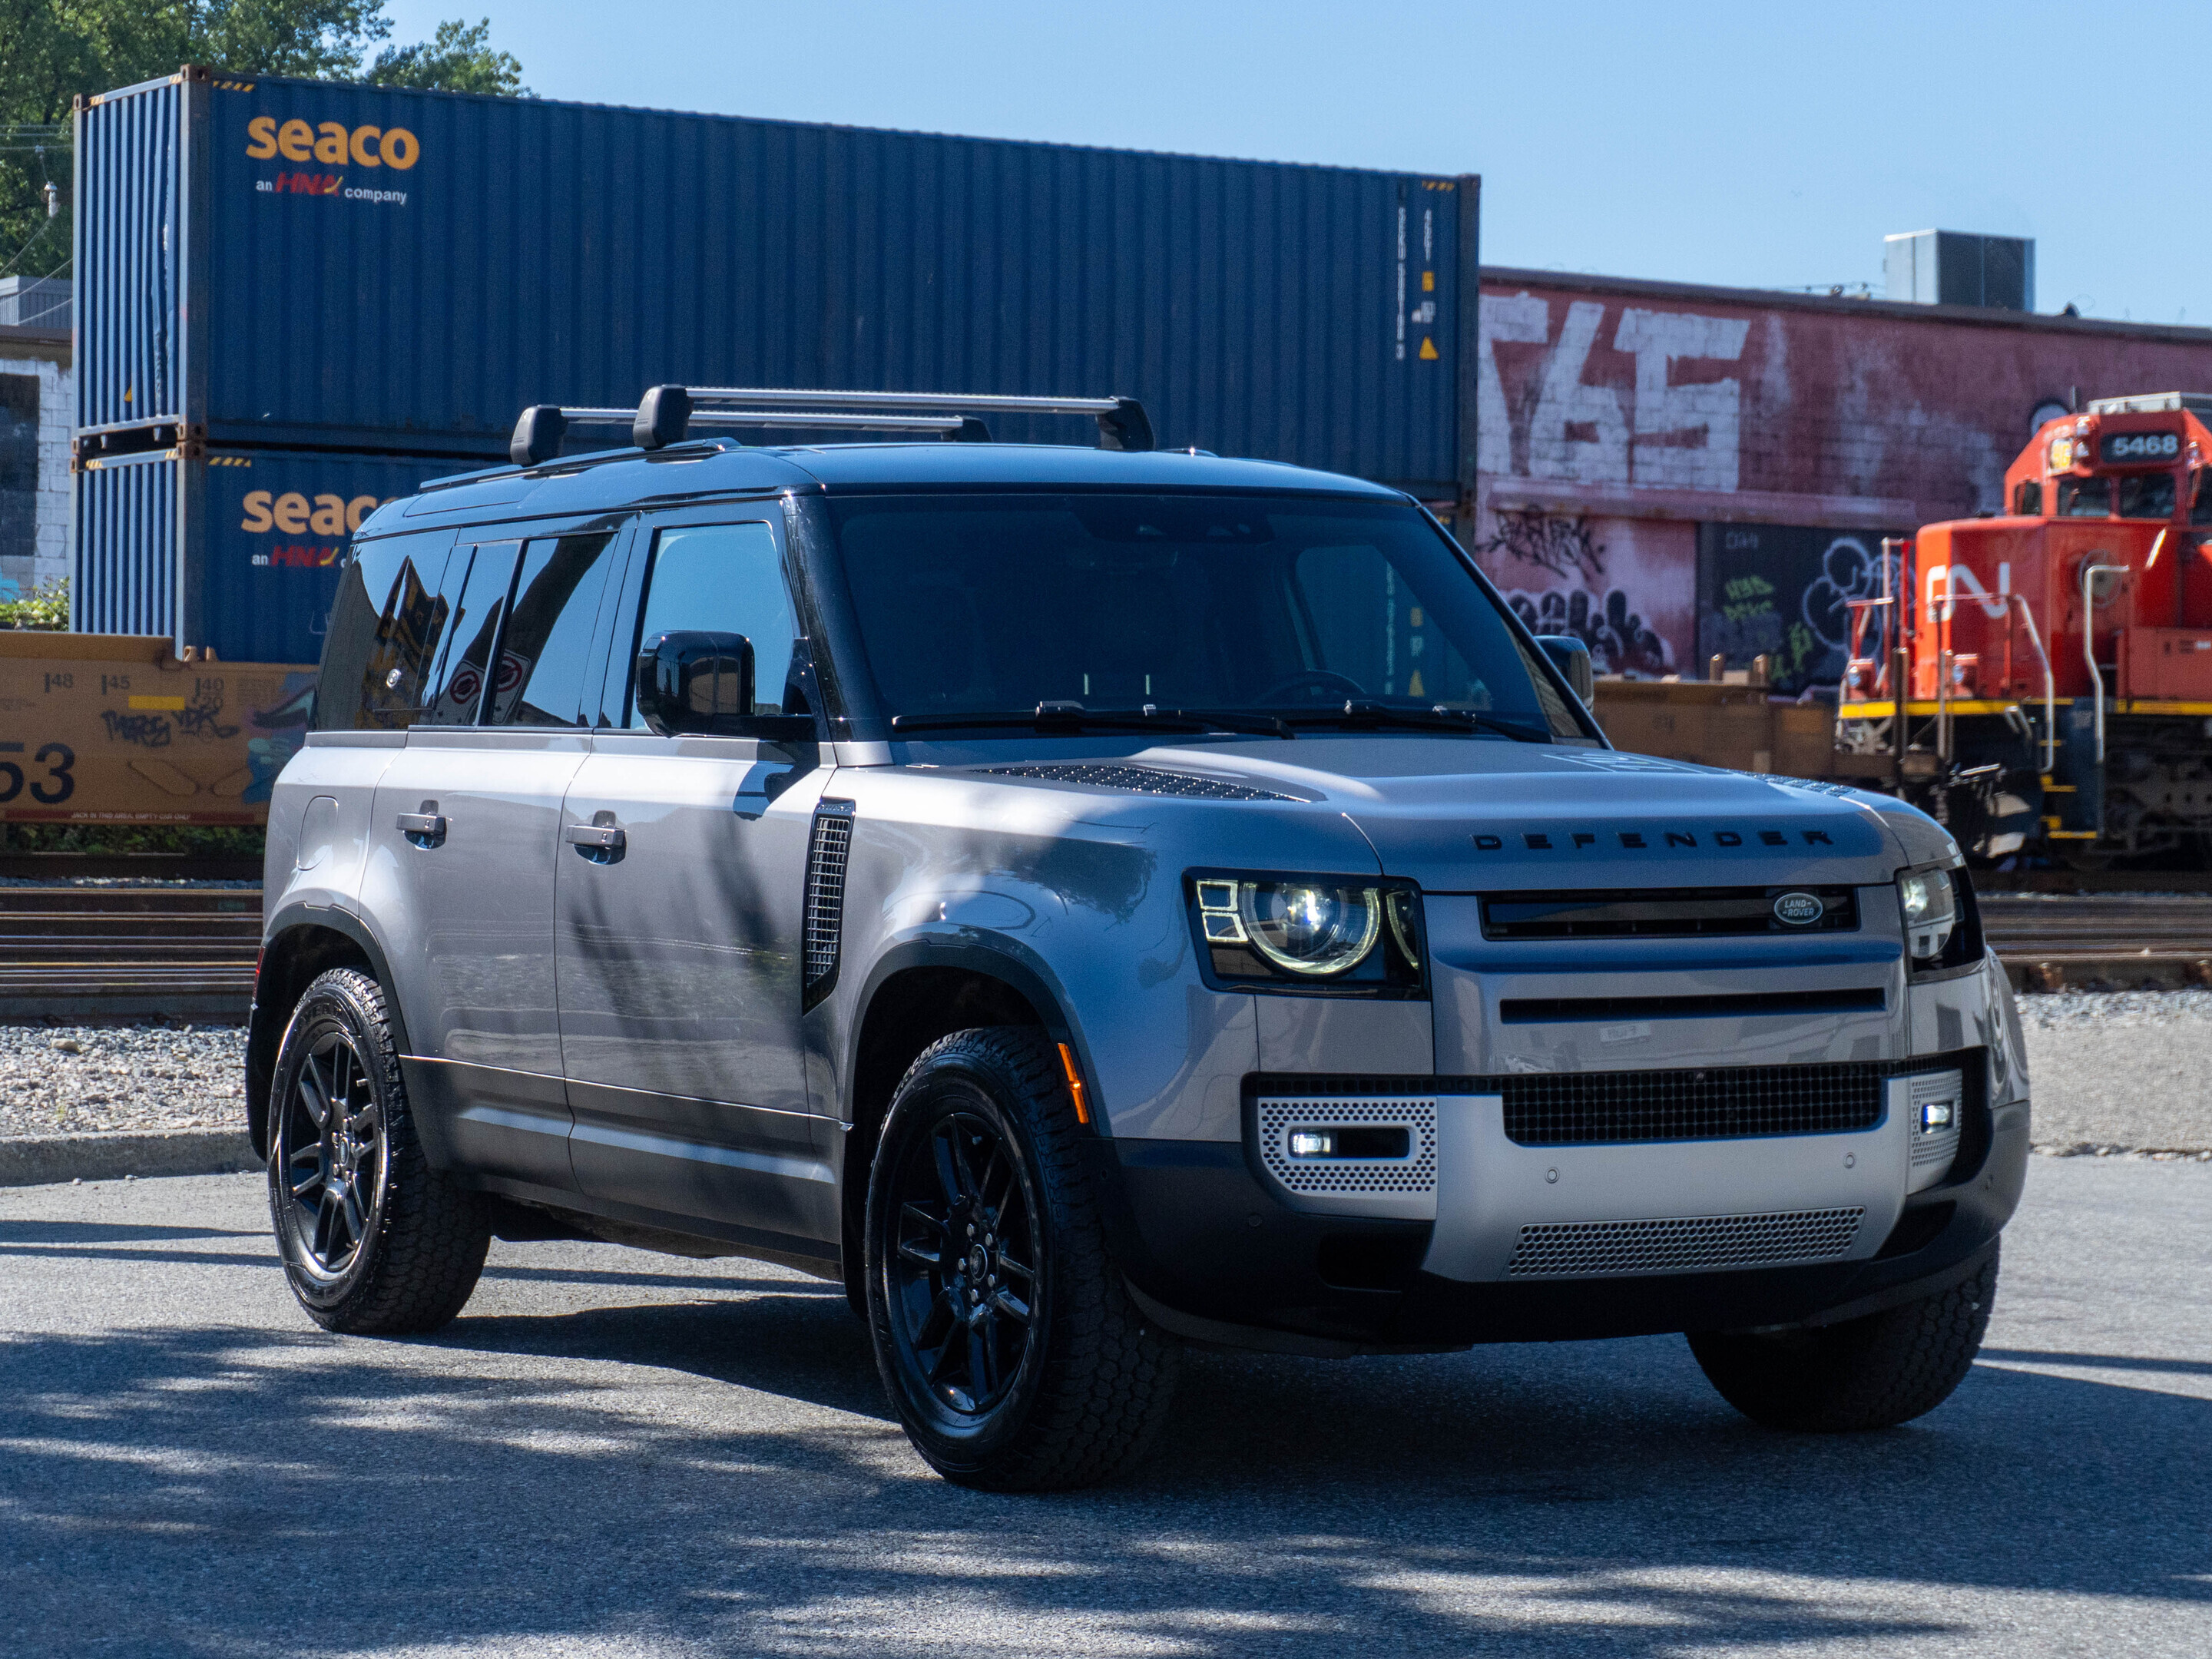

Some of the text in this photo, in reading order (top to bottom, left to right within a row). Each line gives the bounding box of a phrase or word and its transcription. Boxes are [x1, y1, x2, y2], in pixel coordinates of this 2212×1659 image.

[246, 116, 420, 170] seaco
[256, 180, 273, 191] an
[344, 187, 407, 205] company
[2114, 435, 2178, 456] 5468
[241, 490, 398, 536] seac
[252, 554, 269, 566] an
[108, 676, 130, 690] 45
[1471, 830, 1834, 851] DEFENDER
